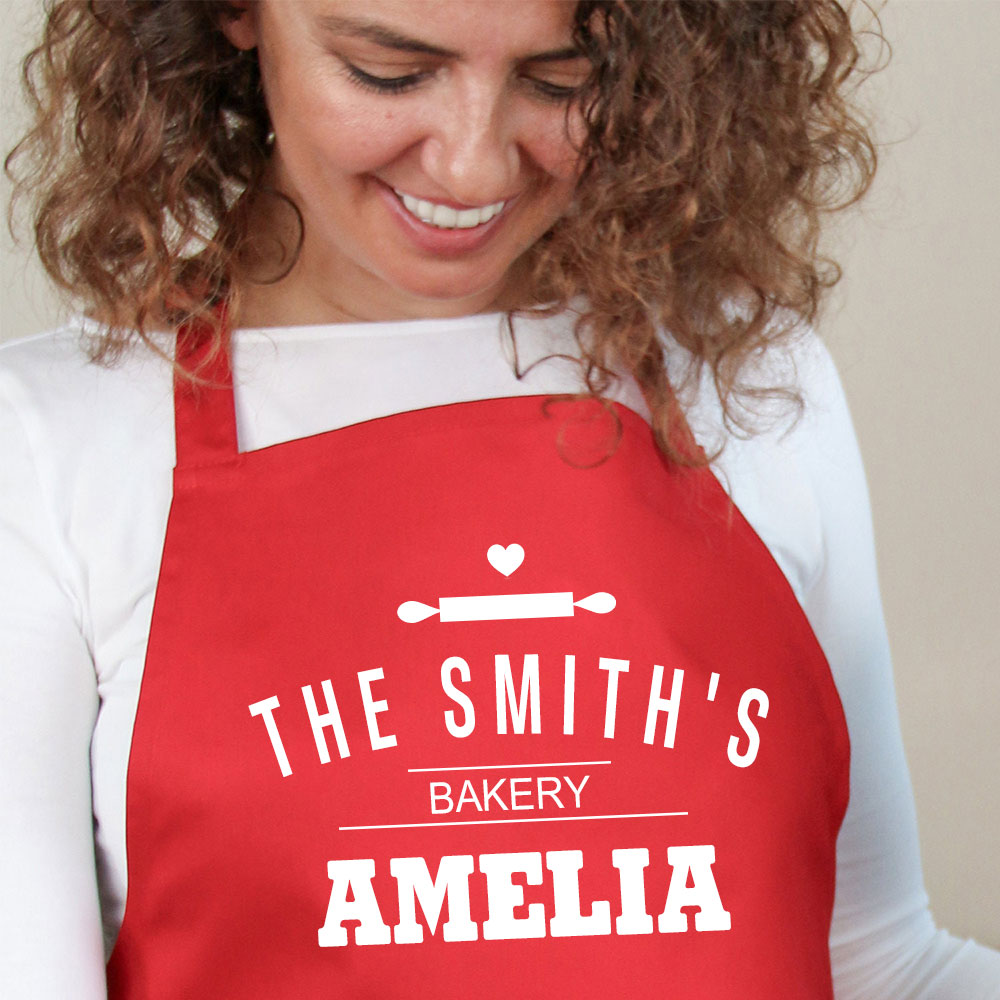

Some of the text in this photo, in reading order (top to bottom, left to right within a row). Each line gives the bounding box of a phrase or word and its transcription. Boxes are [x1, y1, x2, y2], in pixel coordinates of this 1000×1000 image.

[248, 654, 770, 778] THE SMITH'S
[429, 775, 590, 815] BAKERY
[317, 844, 732, 948] AMELIA
